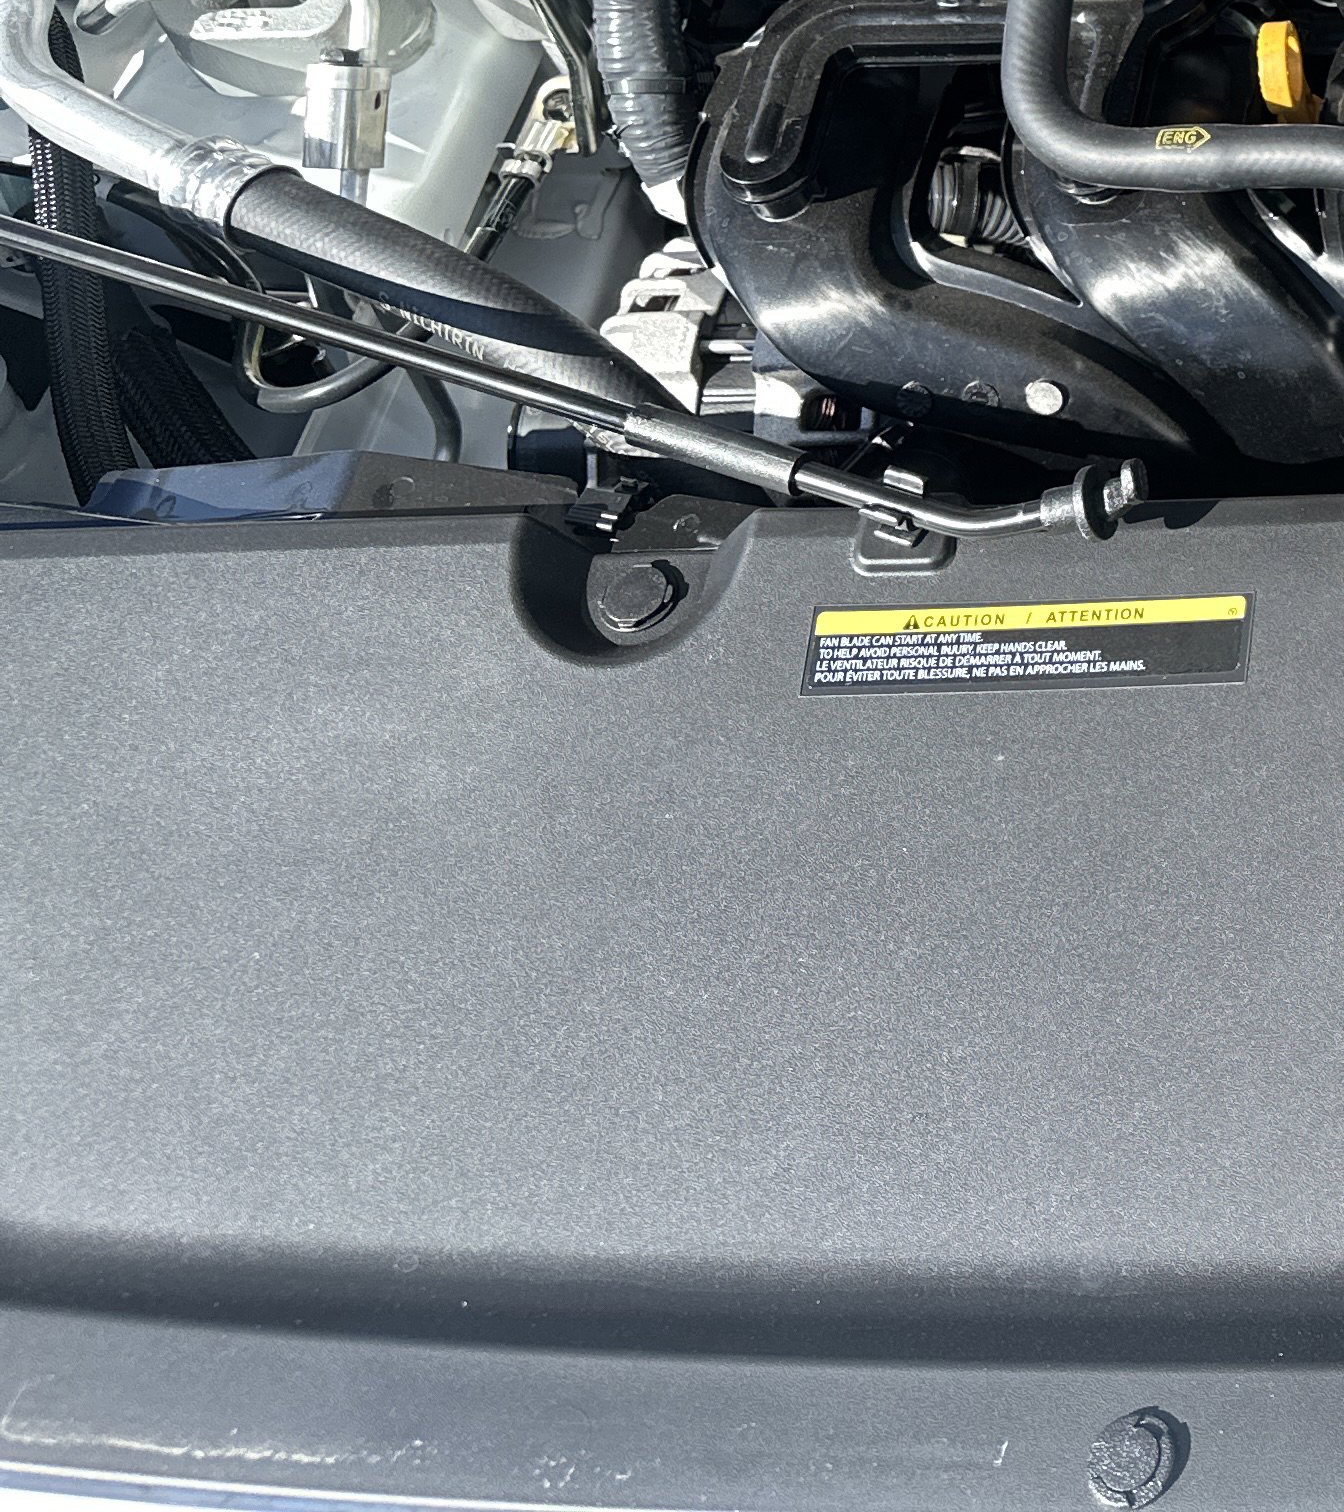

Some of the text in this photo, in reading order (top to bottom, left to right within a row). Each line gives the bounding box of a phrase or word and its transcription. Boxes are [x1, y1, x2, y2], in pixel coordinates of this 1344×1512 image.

[1162, 131, 1197, 145] ENG
[924, 607, 1145, 628] CAUTION / ATTENTION
[819, 632, 983, 647] FAN BLADE CAN START AT ANY TIME.
[819, 640, 1068, 659] TO HELP AVOID PERSONAL INJURY, KEEP HANDS CLEAR.
[816, 650, 1102, 671] LE VENTILATEUR RISQUE DE DÉMARRER À TOUT MOMENT.
[814, 660, 1146, 683] POUR ÉVITER TOUTE BLESSURE, NE PAS EN APPROCHER LES MAINS.
